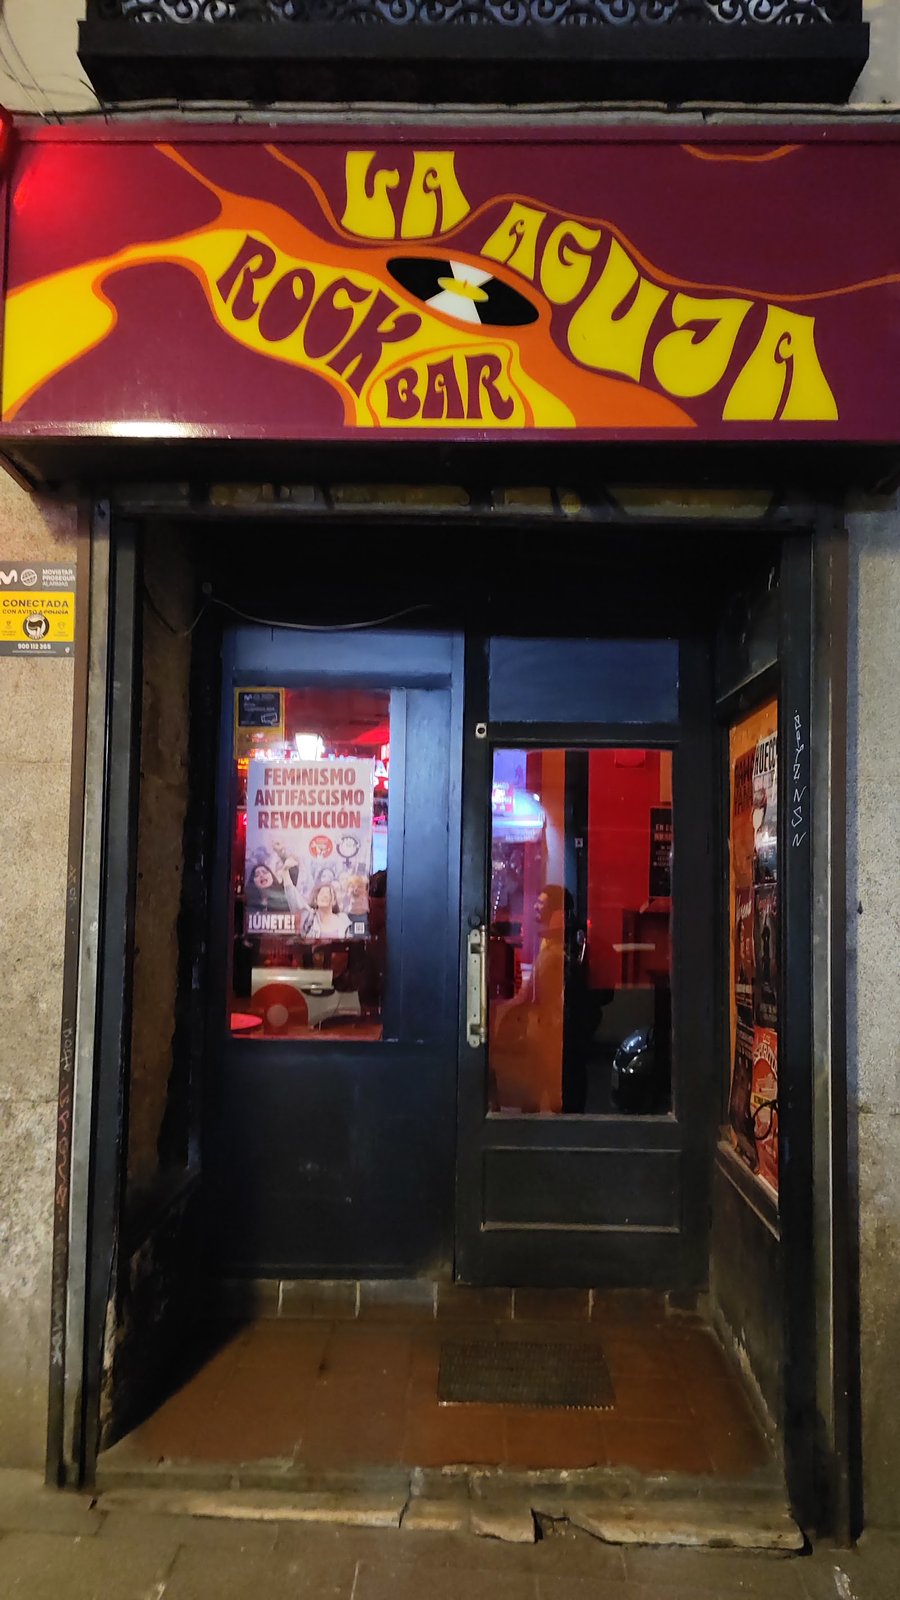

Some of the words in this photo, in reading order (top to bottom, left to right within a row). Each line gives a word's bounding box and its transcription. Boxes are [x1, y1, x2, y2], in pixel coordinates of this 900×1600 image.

[342, 150, 471, 239] LA
[480, 201, 839, 422] AGUJA
[216, 235, 422, 397] ROCK
[385, 353, 513, 420] BAR
[2, 599, 69, 608] CONECTADA
[264, 767, 356, 786] FEMINISMO
[254, 788, 365, 807] ANTIFASCISMO
[257, 807, 361, 829] REVOLUCIÓN
[248, 911, 296, 930] ¡ÚNETE!
